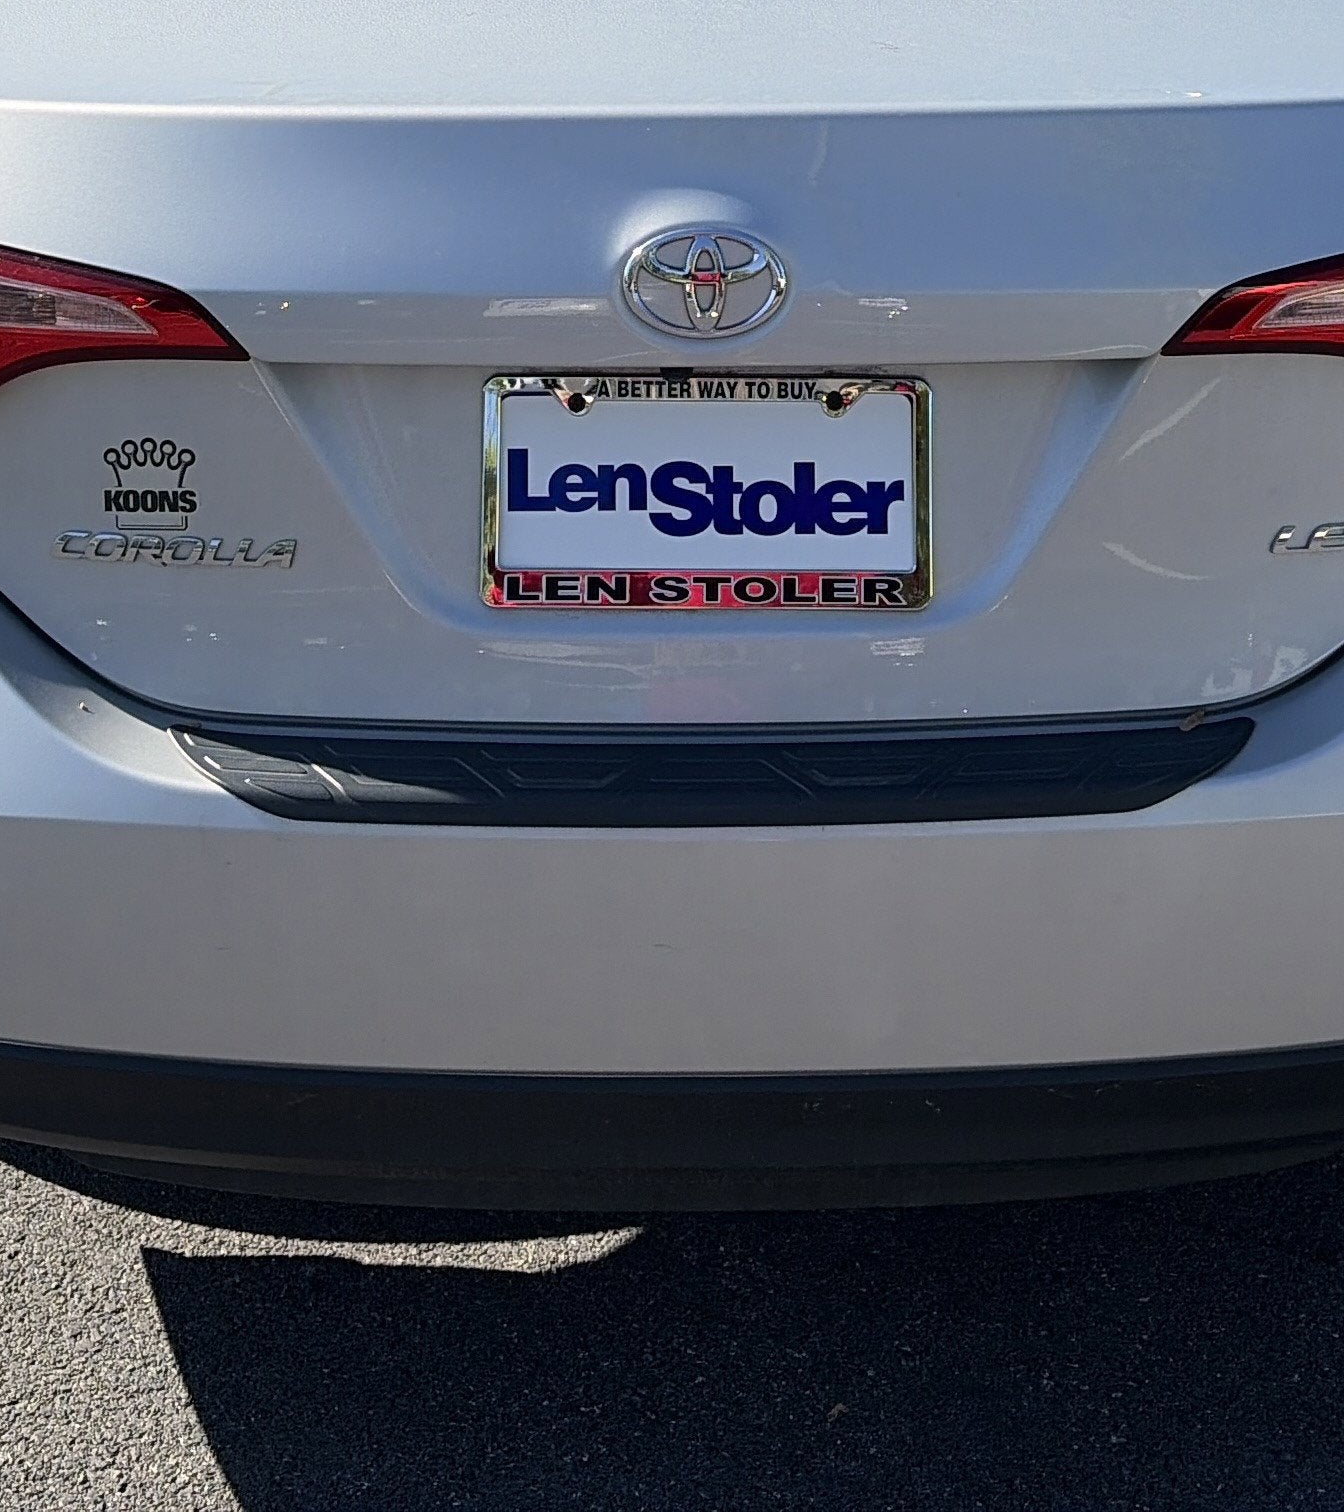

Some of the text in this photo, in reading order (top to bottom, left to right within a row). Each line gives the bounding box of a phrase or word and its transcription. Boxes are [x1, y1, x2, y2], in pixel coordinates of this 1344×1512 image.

[598, 381, 817, 399] A BETTER WAY TO BUY
[104, 489, 197, 513] KOONS
[55, 530, 298, 568] COROLLA
[503, 573, 907, 606] LEN STOLER
